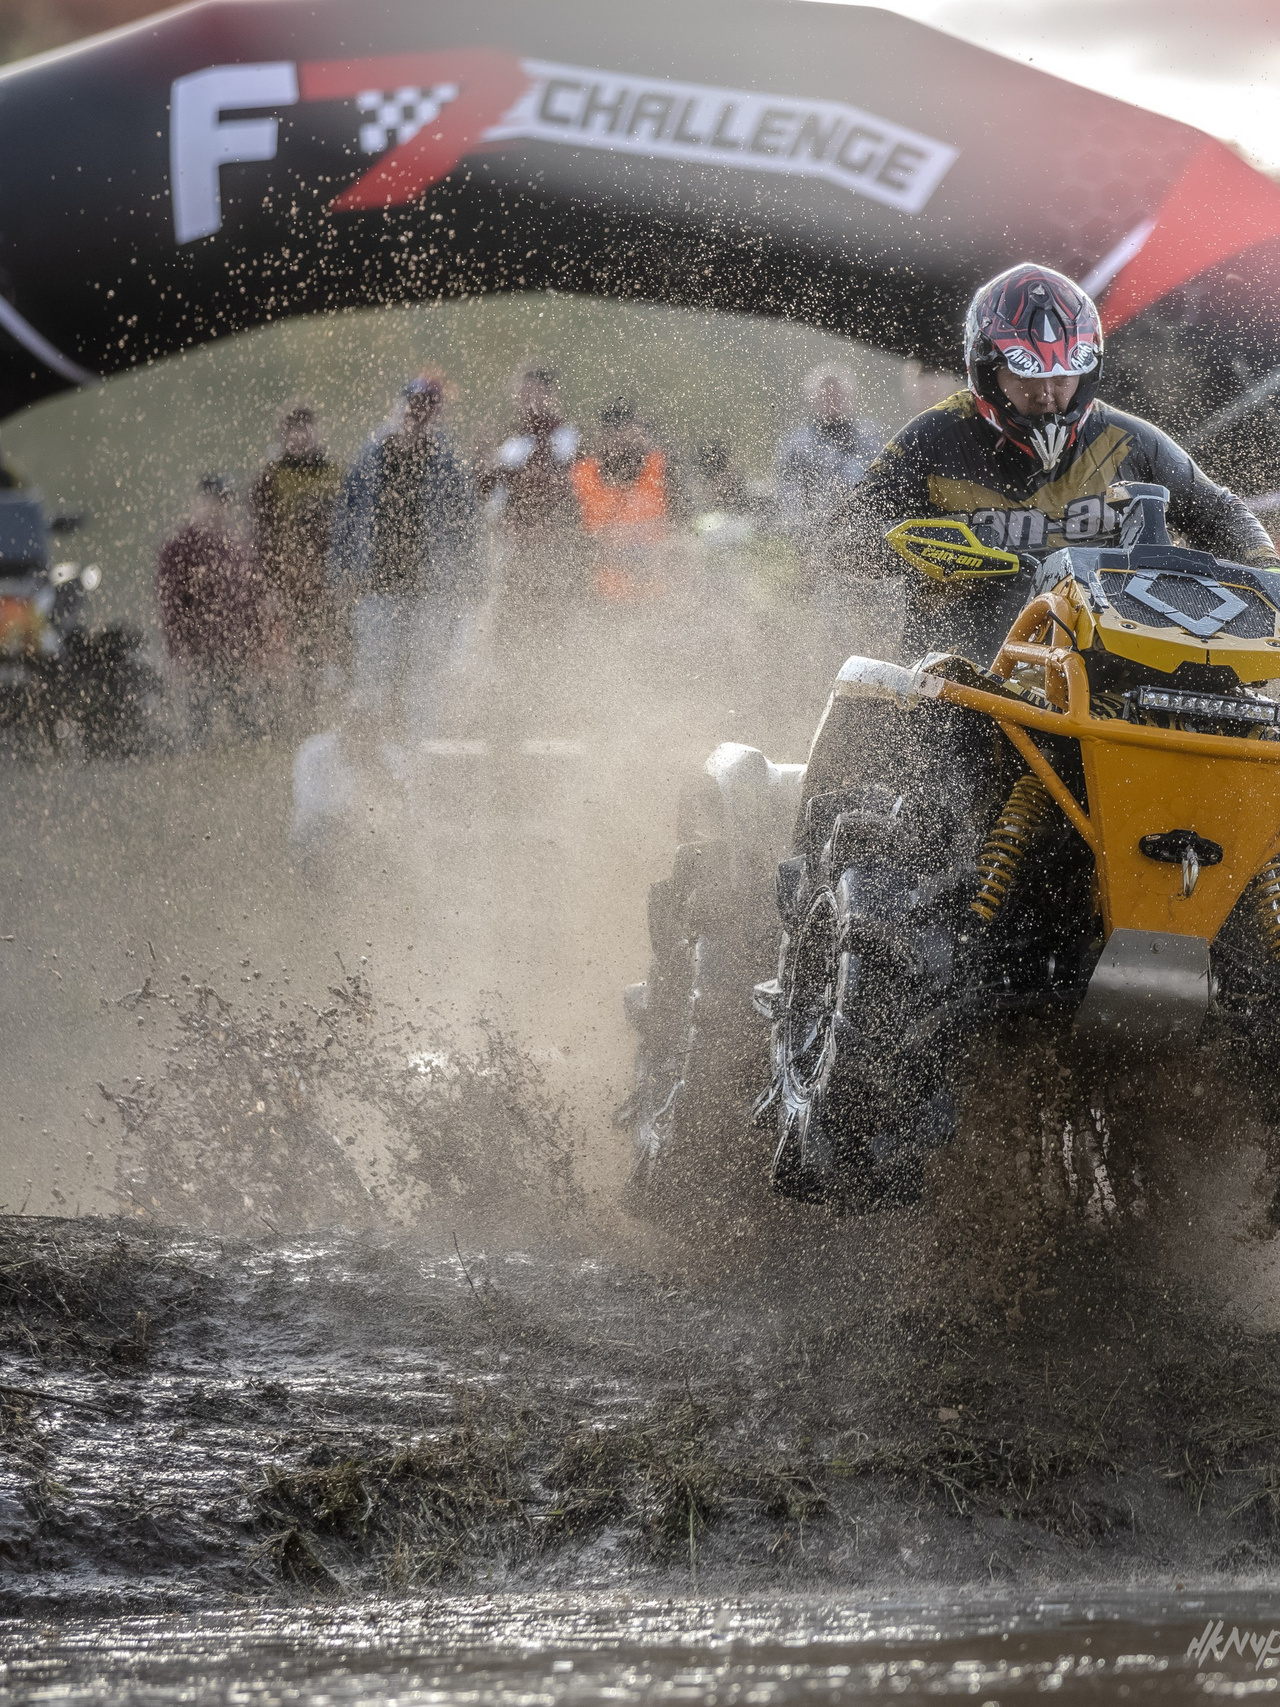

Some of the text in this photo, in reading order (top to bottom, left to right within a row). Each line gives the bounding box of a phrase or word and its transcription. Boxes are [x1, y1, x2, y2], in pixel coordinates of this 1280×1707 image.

[536, 77, 928, 192] CHALLENGE
[1005, 348, 1040, 374] Airoh
[940, 495, 1123, 547] an-a
